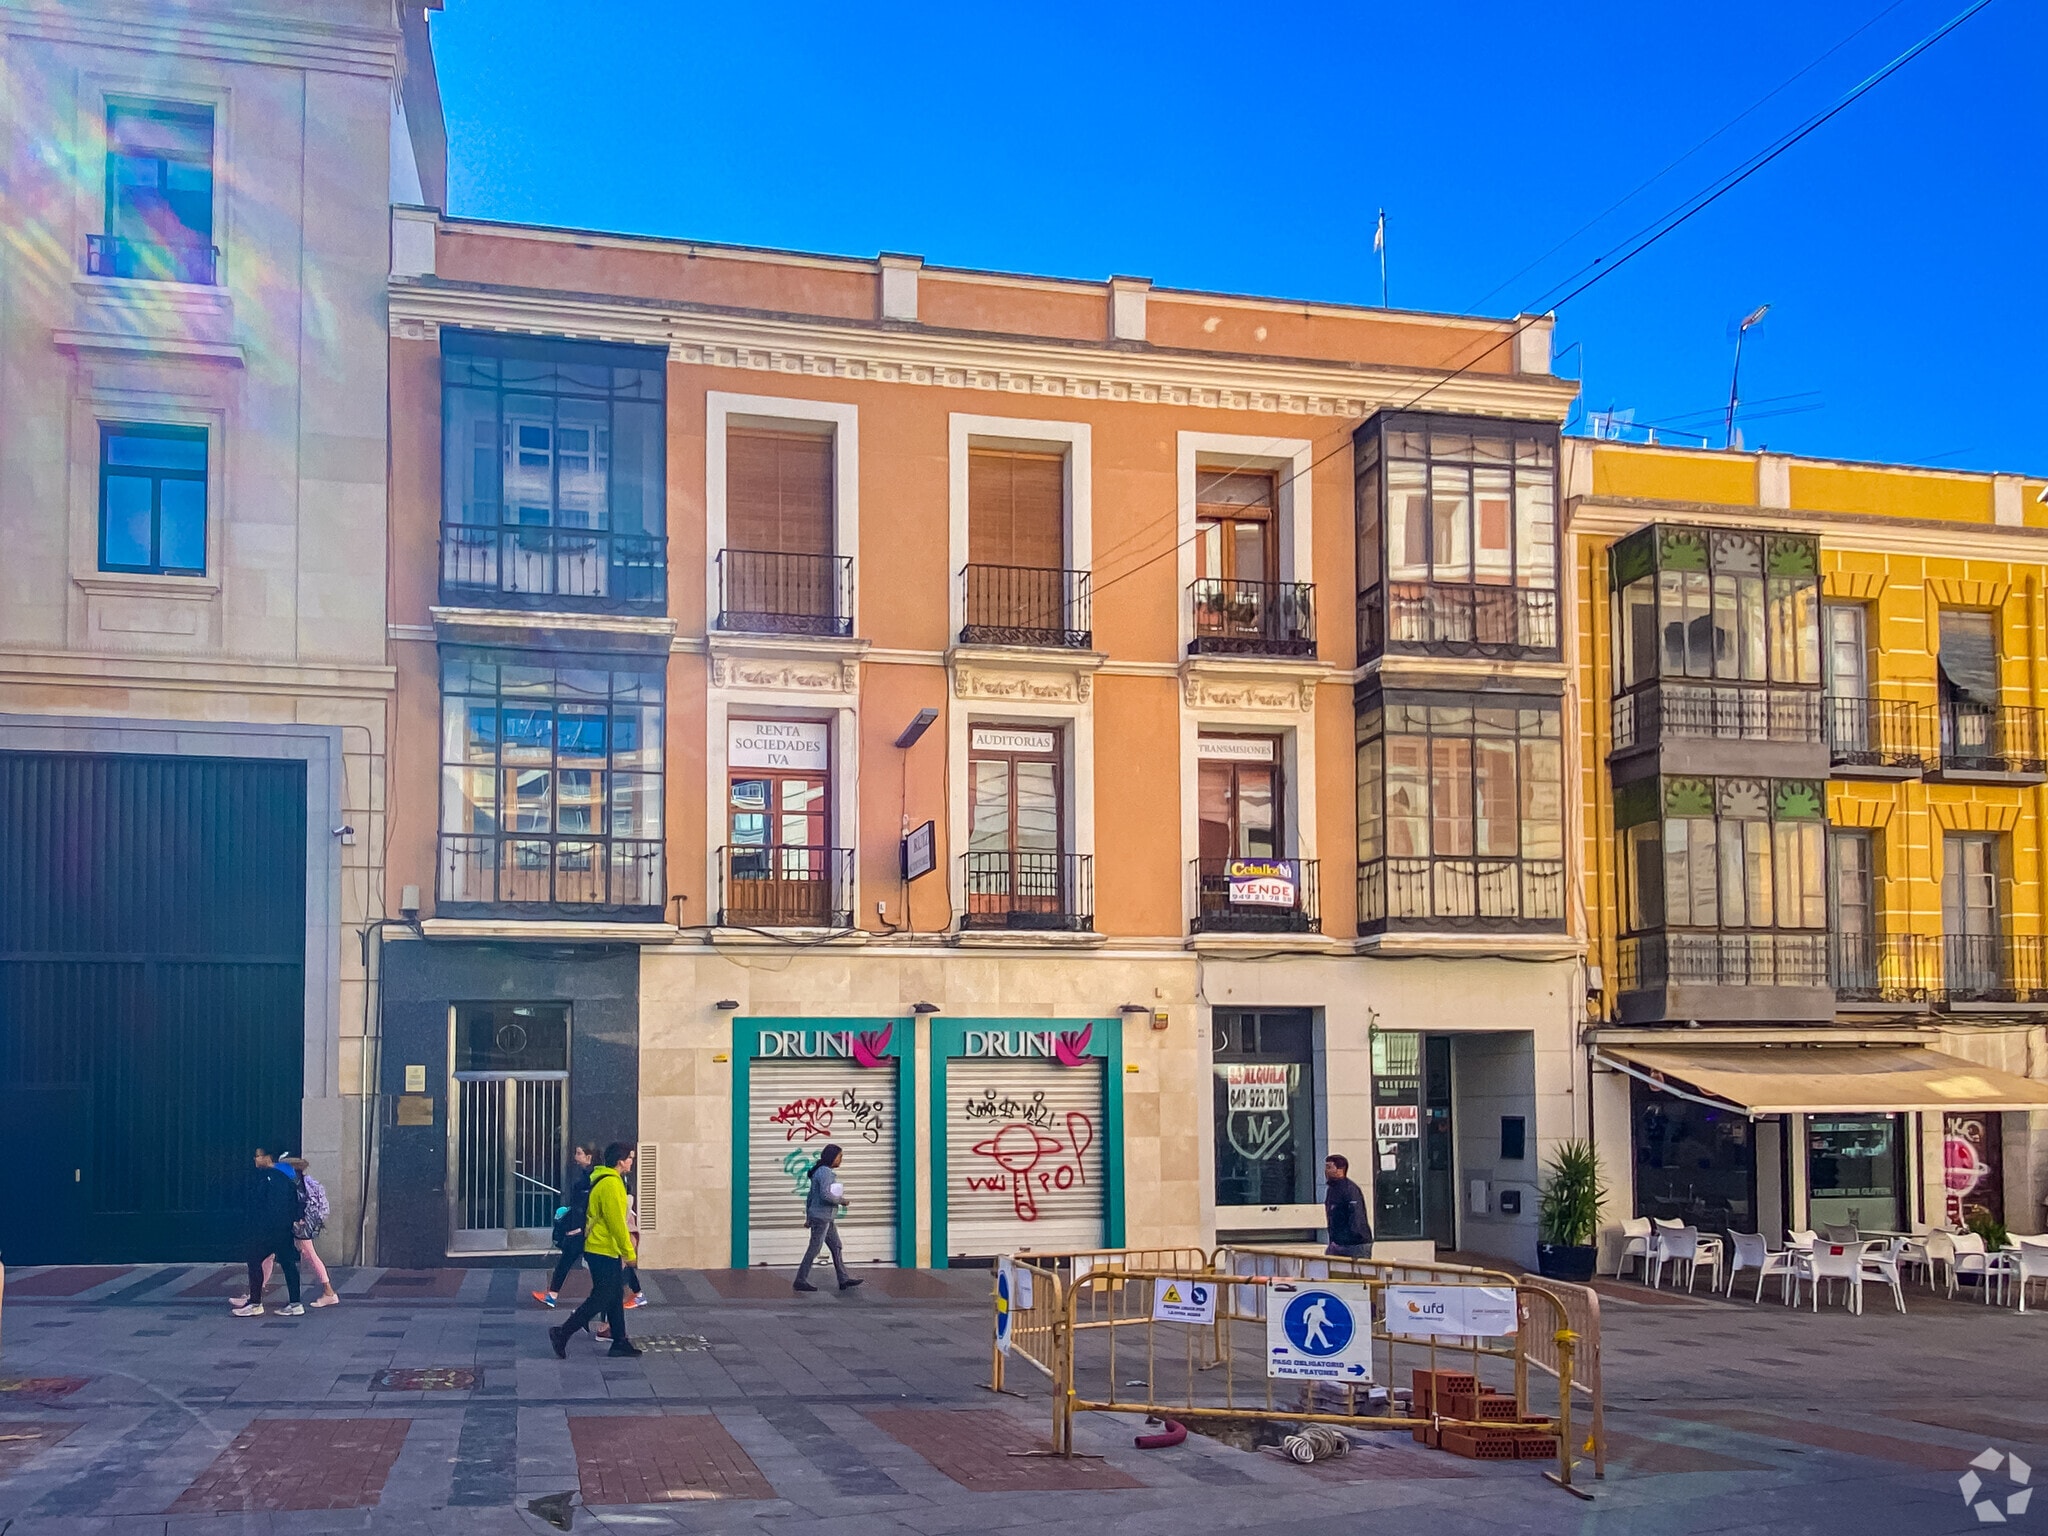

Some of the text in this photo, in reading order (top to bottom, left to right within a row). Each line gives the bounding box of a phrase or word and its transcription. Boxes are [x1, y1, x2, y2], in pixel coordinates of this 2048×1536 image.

[756, 724, 801, 737] RENTA
[735, 738, 821, 752] SOCIEDADES
[976, 734, 1050, 748] AUDITORIAS
[1198, 744, 1271, 755] TRANSMISIONES
[767, 754, 790, 765] IVA
[1235, 884, 1290, 896] VENDE
[758, 1030, 854, 1057] DRUNI
[964, 1030, 1056, 1057] DRUNI
[1244, 1066, 1285, 1085] ALQUILA
[1387, 1107, 1416, 1120] ALQUILA
[1423, 1303, 1444, 1314] ufd
[1294, 1360, 1345, 1368] OBLIGATORIO
